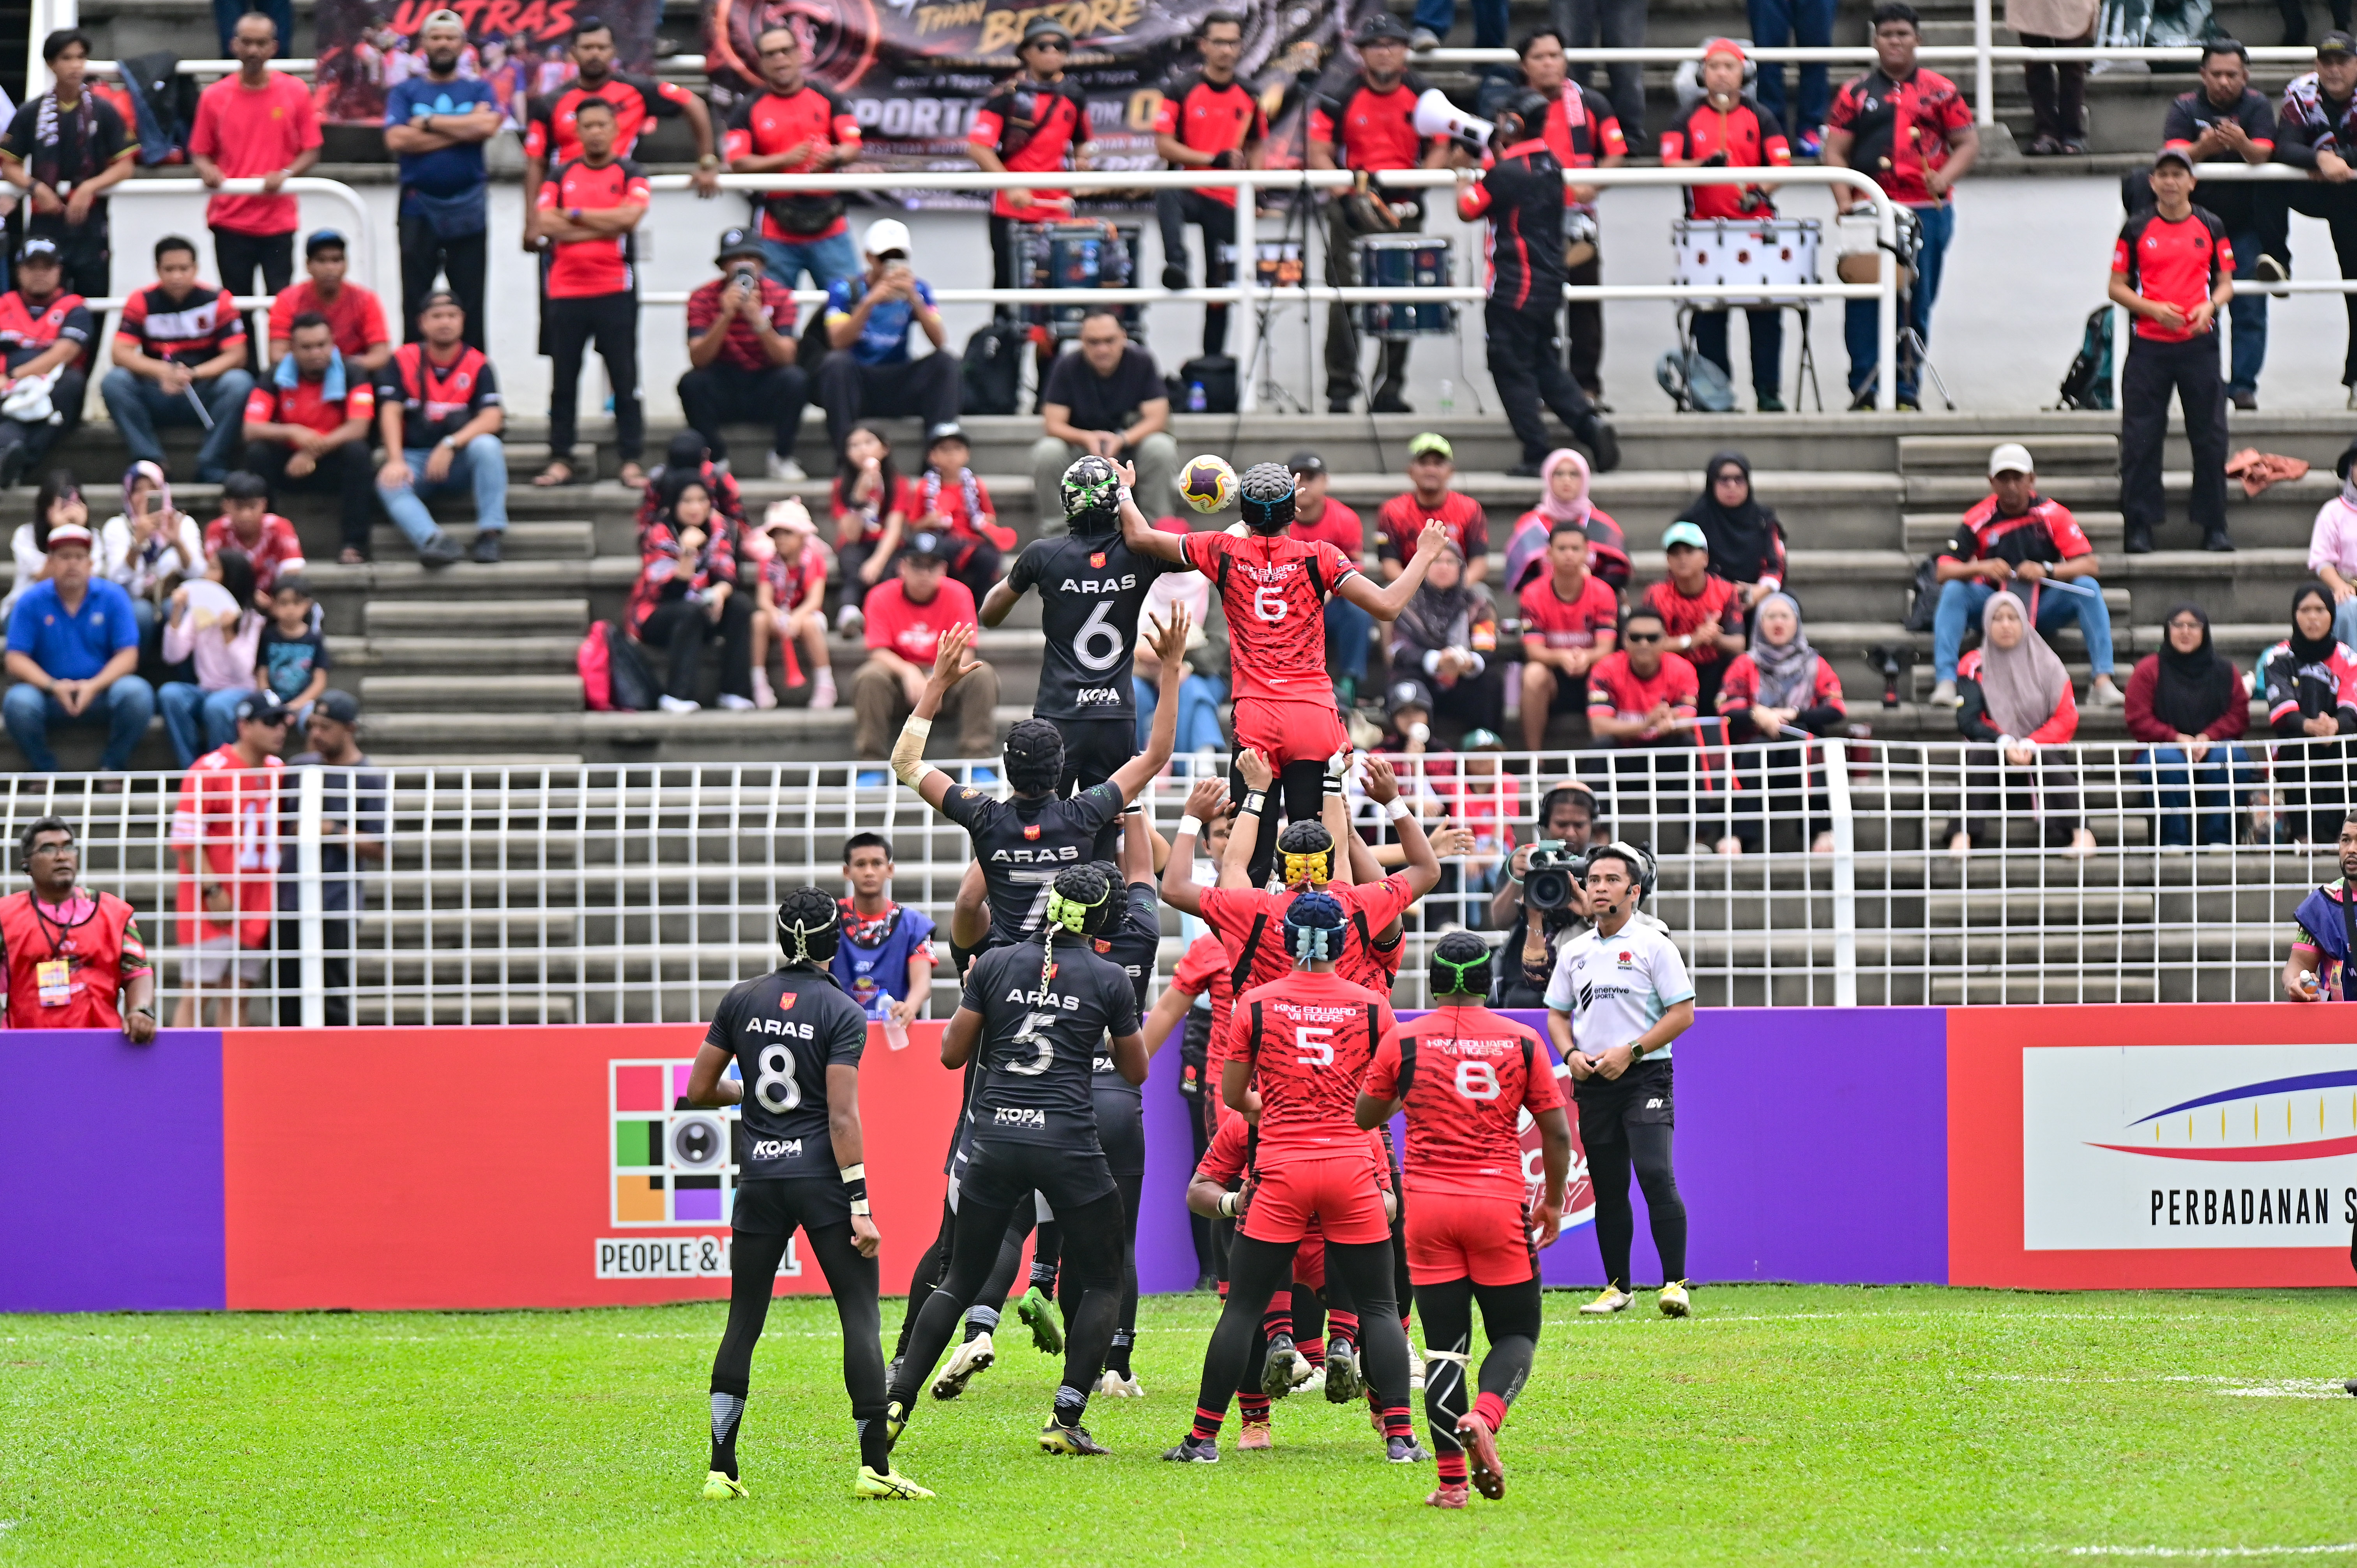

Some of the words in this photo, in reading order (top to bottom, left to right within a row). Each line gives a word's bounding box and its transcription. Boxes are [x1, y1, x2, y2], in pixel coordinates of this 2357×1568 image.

[394, 0, 577, 40] UTRAS
[842, 97, 987, 136] PORT
[1237, 563, 1257, 574] KING
[1060, 574, 1136, 593] ARAS
[1254, 586, 1288, 620] 6
[1073, 600, 1124, 670] 6
[1077, 688, 1120, 702] KOPA
[990, 846, 1079, 863] ARAS
[1009, 869, 1062, 932] 7
[1006, 989, 1080, 1011] ARAS
[1274, 1004, 1301, 1013] KING
[1303, 1006, 1356, 1016] EDWARD
[1288, 1012, 1301, 1020] VII
[1303, 1013, 1344, 1022] TIGERS
[746, 1017, 814, 1040] ARAS
[1005, 1012, 1056, 1076] 5
[1296, 1027, 1334, 1066] 5
[1427, 1039, 1457, 1047] KING
[1459, 1039, 1514, 1048] EDWARD
[1459, 1046, 1503, 1056] TIGERS
[1093, 1057, 1115, 1069] PA
[755, 1043, 801, 1114] 8
[1455, 1061, 1501, 1100] 8
[995, 1107, 1045, 1125] KOPA
[995, 1120, 1045, 1129] GROUP
[753, 1139, 802, 1155] KOPA
[753, 1151, 802, 1160] GROUP
[2152, 1187, 2328, 1226] PERBADANAN
[603, 1243, 691, 1272] PEOPLE
[701, 1242, 718, 1271] &
